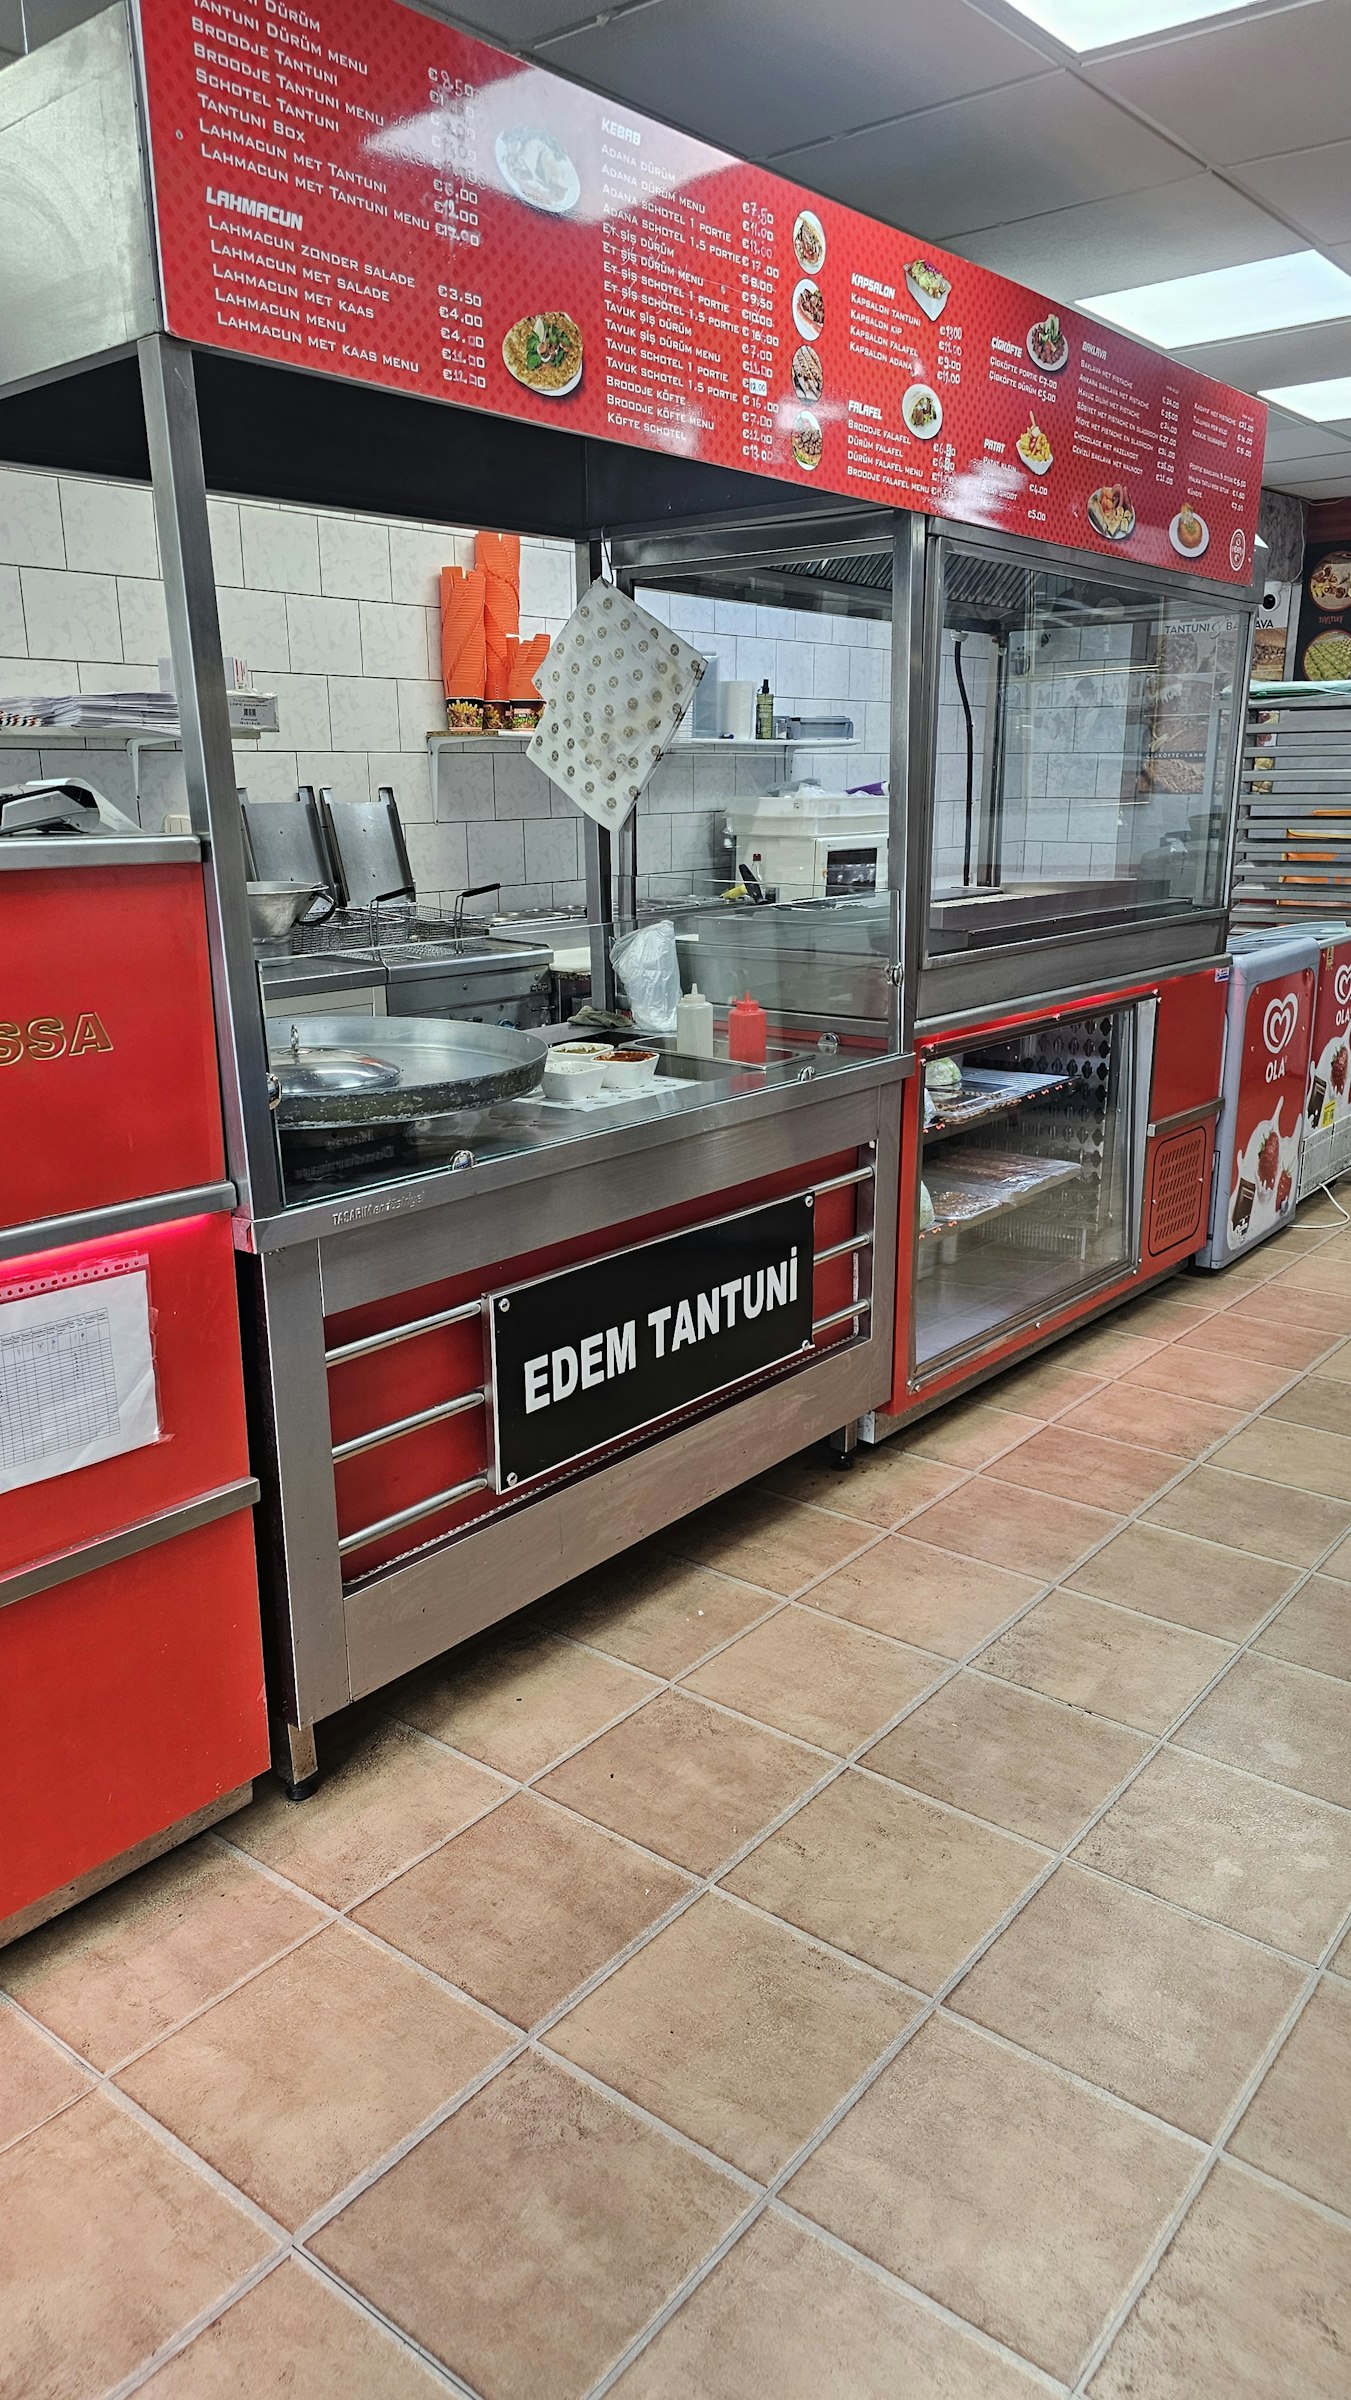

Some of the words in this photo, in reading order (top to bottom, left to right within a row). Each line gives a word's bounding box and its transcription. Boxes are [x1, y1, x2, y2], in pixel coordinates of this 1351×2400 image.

[265, 0, 320, 32] DÜRÜM
[192, 16, 269, 59] BROODJE
[274, 49, 338, 86] TANTUNI
[267, 22, 322, 56] DÜRÜM
[328, 49, 367, 75] MENU
[193, 42, 270, 84] BROODJE
[276, 73, 339, 110] TANTUNI
[345, 103, 384, 126] MENU
[196, 68, 271, 108] SCHOTEL
[276, 97, 339, 132] TANTUNI
[197, 93, 265, 129] TANTUNI
[273, 120, 305, 143] BOX
[601, 117, 641, 146] KEBAB
[199, 118, 287, 160] LAHMACUN
[293, 153, 322, 172] MET
[328, 162, 387, 194] TANTUNI
[601, 144, 637, 167] ADANA
[641, 162, 675, 183] DÜRÜM
[201, 143, 289, 184] LAHMACUN
[295, 176, 324, 195] MET
[329, 186, 388, 217] TANTUNI
[393, 210, 430, 231] MENU
[602, 164, 637, 186] ADANA
[641, 181, 675, 202] DÜRÜM
[679, 196, 705, 214] MENU
[206, 186, 303, 231] LAHMACUN
[603, 184, 637, 205] ADANA
[641, 201, 685, 225] SCHOTEL
[690, 218, 694, 228] 1
[700, 223, 731, 243] PORTIE
[603, 203, 638, 226] ADANA
[641, 220, 685, 243] SCHOTEL
[690, 236, 706, 251] 1.5
[709, 245, 740, 264] PORTIE
[640, 237, 674, 258] DÜRÜM
[208, 215, 295, 252] LAHMACUN
[301, 244, 359, 272] ZONDER
[364, 264, 415, 288] SALADE
[437, 284, 482, 308] €3.50
[678, 270, 704, 287] MENU
[210, 239, 296, 276] LAHMACUN
[302, 268, 331, 285] MET
[337, 278, 390, 302] SALADE
[439, 306, 483, 328] €4.00
[212, 263, 298, 299] LAHMACUN
[304, 290, 333, 308] MET
[338, 300, 374, 319] KAAS
[641, 276, 684, 298] SCHOTEL
[698, 295, 730, 313] PORTIE
[851, 273, 896, 300] KAPSALON
[214, 288, 300, 322] LAHMACUN
[306, 314, 346, 334] MENU
[604, 300, 636, 319] TAVUK
[659, 318, 692, 336] DÜRÜM
[641, 294, 684, 317] SCHOTEL
[689, 309, 705, 323] 1.5
[708, 316, 740, 334] PORTIE
[850, 309, 888, 331] KAPSALON
[890, 325, 902, 336] KIP
[851, 293, 889, 316] KAPSALON
[891, 309, 921, 327] TANTUNI
[217, 311, 302, 344] LAHMACUN
[308, 335, 336, 353] MET
[342, 345, 377, 363] KAAS
[382, 355, 419, 373] MENU
[605, 319, 636, 338] TAVUK
[659, 336, 692, 354] DÜRÜM
[695, 348, 720, 363] MENU
[849, 341, 887, 362] KAPSALON
[889, 356, 912, 371] ADANA
[850, 325, 888, 347] KAPSALON
[889, 341, 918, 357] FALAFEL
[1082, 341, 1107, 360] BAKLAVA
[605, 338, 637, 356] TAVUK
[640, 349, 683, 370] SCHOTEL
[688, 362, 692, 372] 1
[697, 366, 728, 382] PORTIE
[606, 356, 637, 374] TAVUK
[641, 367, 683, 387] SCHOTEL
[689, 380, 704, 393] 1.5
[708, 386, 738, 402] PORTIE
[606, 375, 653, 396] BROODJE
[656, 389, 685, 405] KÖFTE
[607, 394, 653, 414] BROODJE
[657, 407, 686, 423] KÖFTE
[690, 416, 714, 430] MENU
[607, 412, 640, 430] KÖFTE
[643, 423, 685, 440] SCHOTEL
[848, 400, 882, 420] FALAFEL
[848, 419, 881, 436] BROODJE
[883, 430, 911, 445] FALAFEL
[848, 434, 873, 450] DÜRÜM
[875, 443, 903, 458] FALAFEL
[984, 438, 1005, 454] PATAT
[847, 450, 873, 465] DÜRÜM
[875, 459, 903, 473] FALAFEL
[905, 466, 923, 477] MENU
[847, 466, 880, 482] BROODJE
[882, 475, 910, 489] FALAFEL
[911, 482, 929, 494] MENU
[1165, 623, 1210, 634] TANTUNI
[1335, 1008, 1350, 1026] OLA
[1265, 1056, 1286, 1083] OLA
[524, 1319, 637, 1414] EDEM
